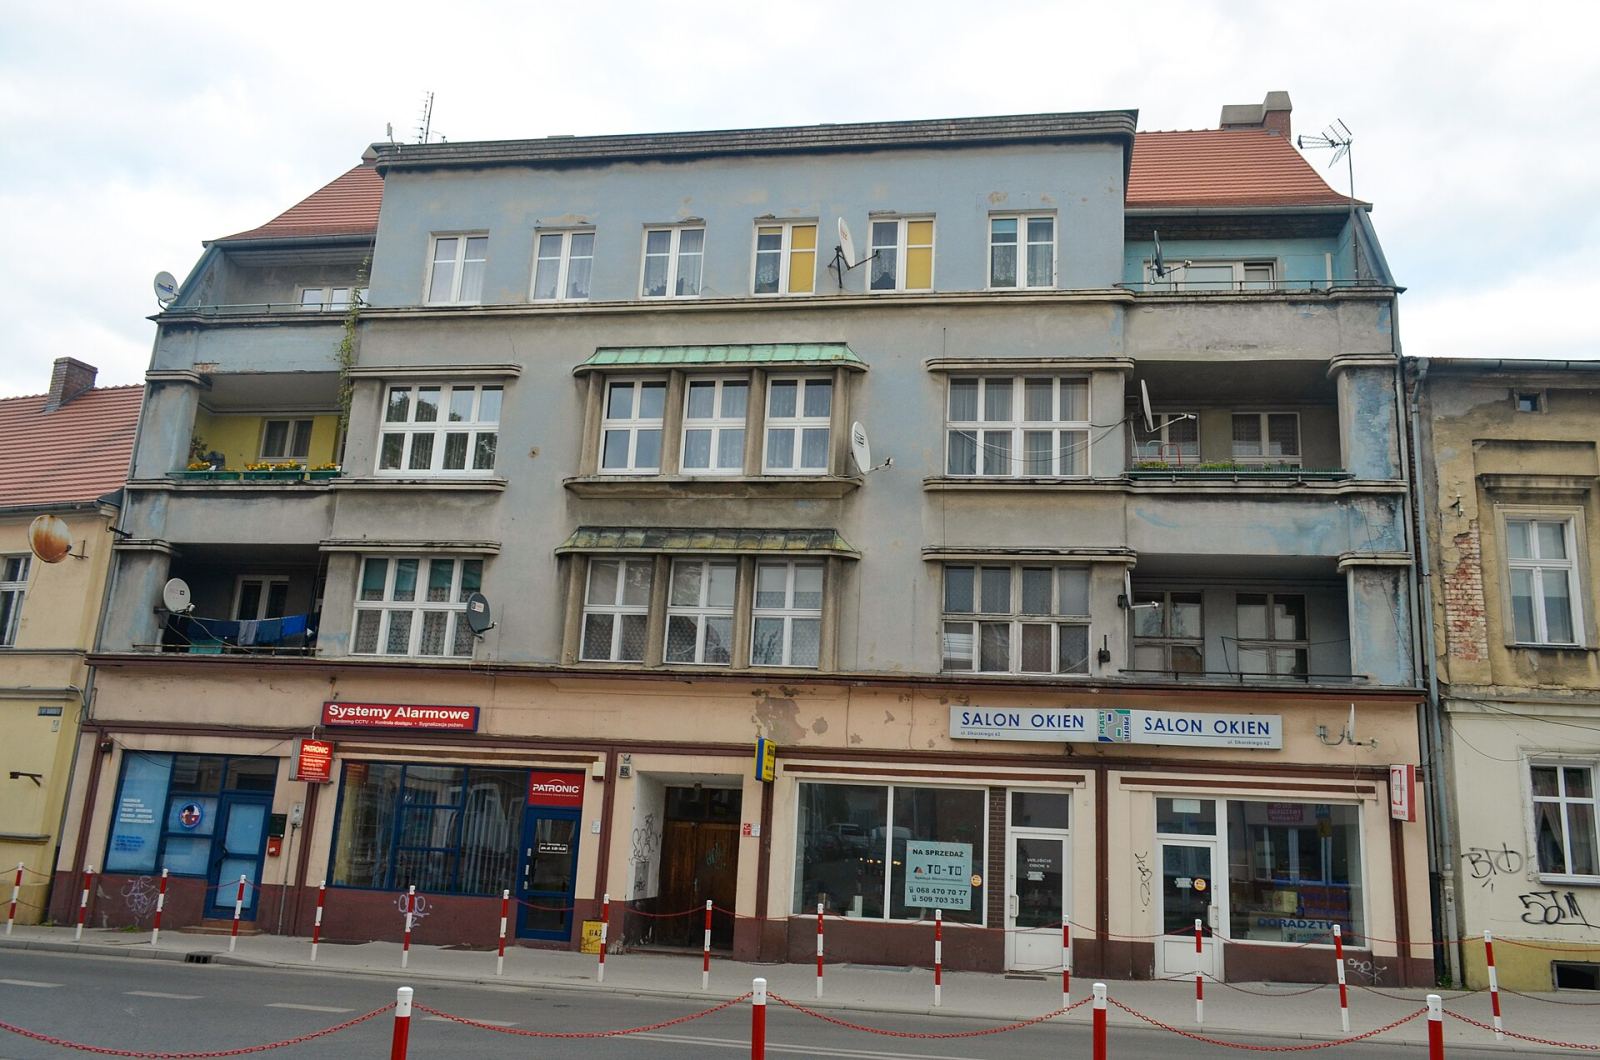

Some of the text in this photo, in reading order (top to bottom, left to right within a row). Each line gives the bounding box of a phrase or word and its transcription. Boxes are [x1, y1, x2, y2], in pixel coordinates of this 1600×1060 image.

[328, 705, 470, 720] Systemy Alarmowe
[961, 712, 1084, 728] SALON OKIEN
[1144, 716, 1270, 735] SALON OKIEN
[303, 744, 329, 754] PATRONIC
[532, 783, 580, 794] PATRONIC
[912, 848, 965, 858] NA SPRZEDAŻ
